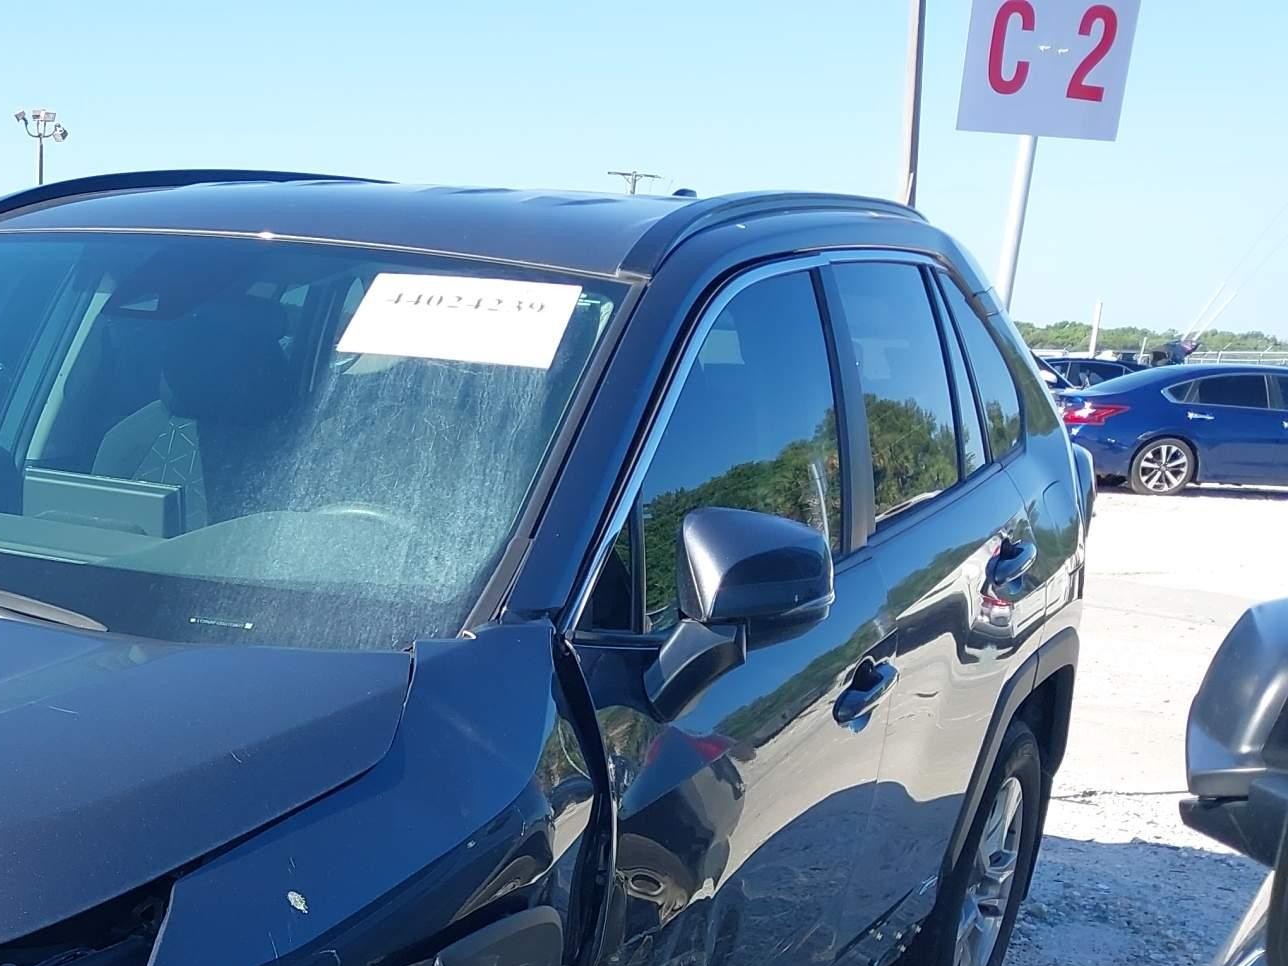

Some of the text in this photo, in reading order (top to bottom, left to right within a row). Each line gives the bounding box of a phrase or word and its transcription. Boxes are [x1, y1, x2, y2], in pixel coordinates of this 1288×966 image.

[988, 0, 1118, 102] C 2
[386, 292, 545, 313] 44024239
